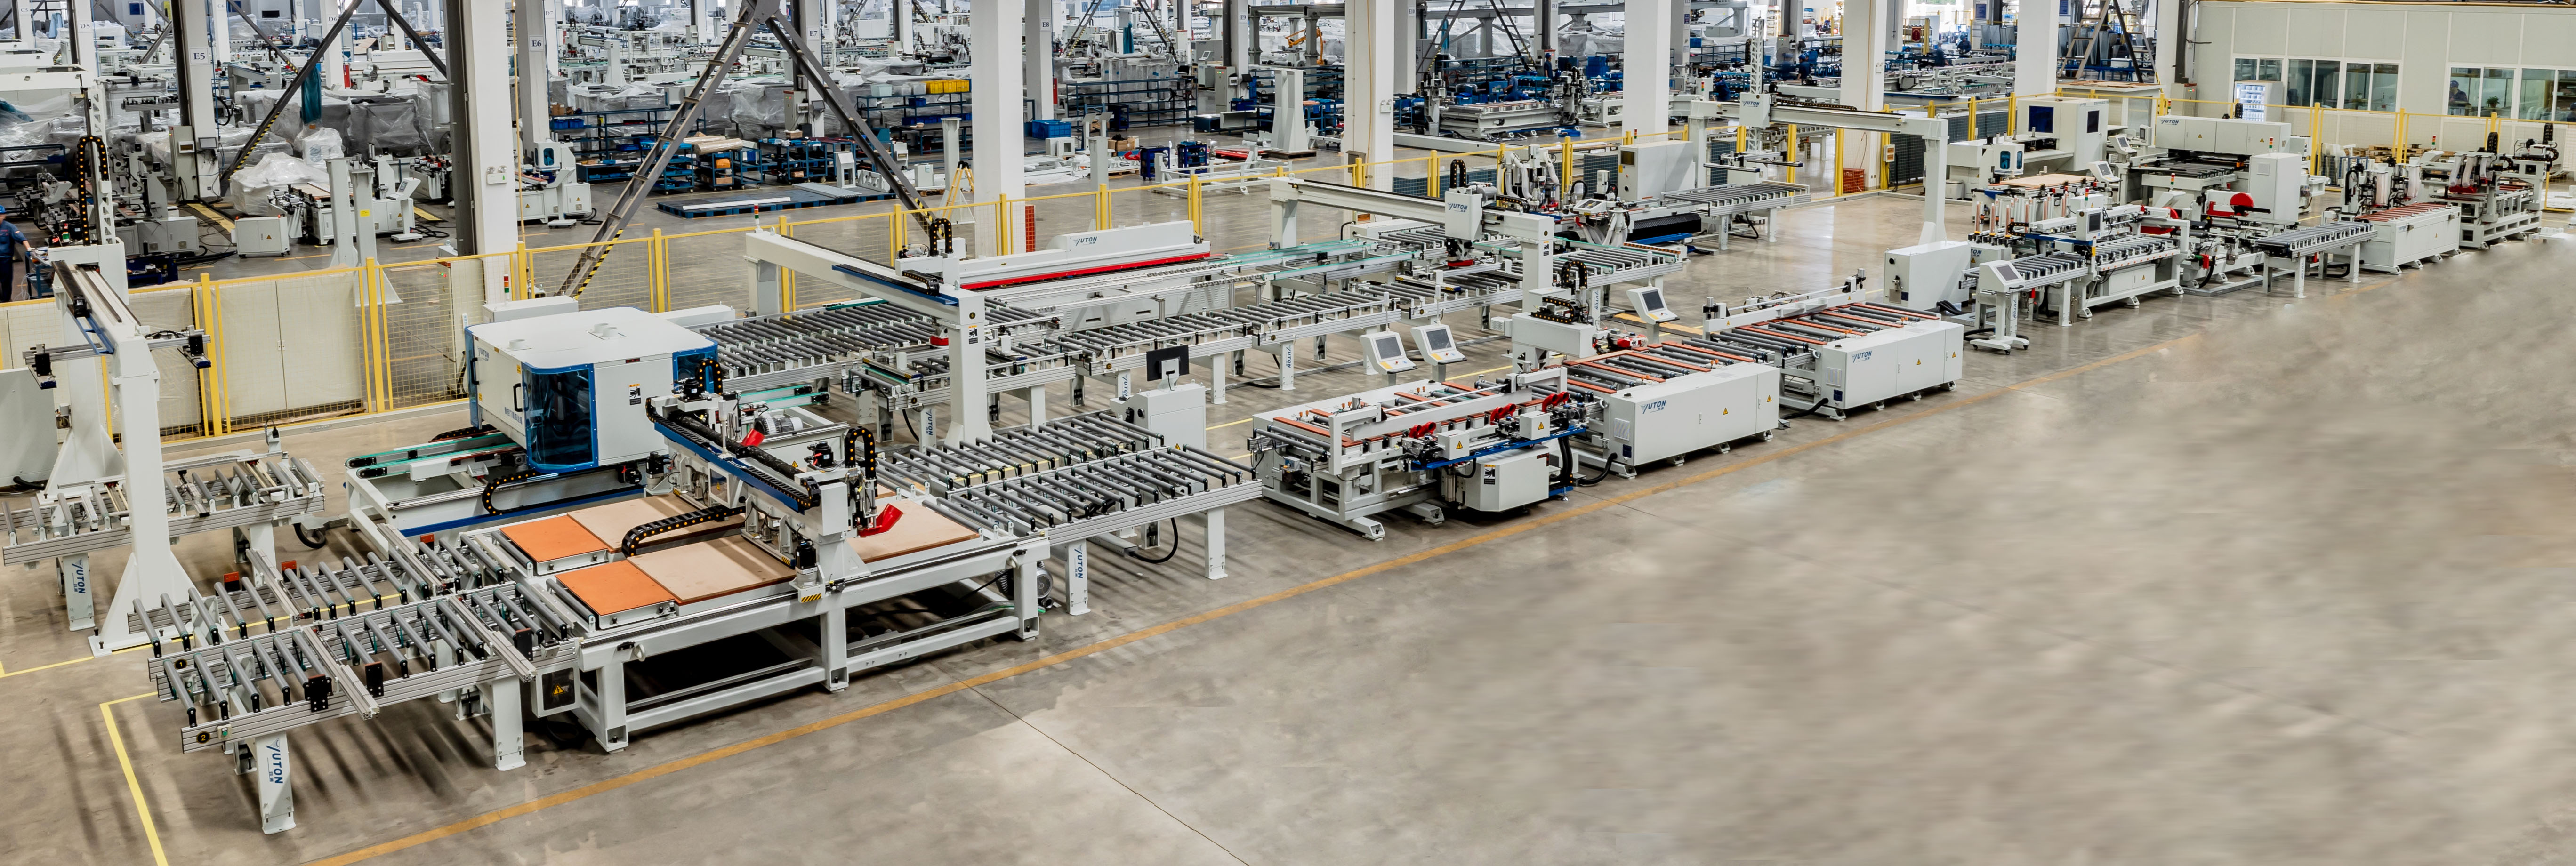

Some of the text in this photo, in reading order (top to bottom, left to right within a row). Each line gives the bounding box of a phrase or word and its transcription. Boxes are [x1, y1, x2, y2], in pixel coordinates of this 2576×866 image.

[1073, 236, 1097, 246] YUTON
[1851, 351, 1872, 363] YUTON
[1640, 400, 1666, 414] YUTON
[1074, 544, 1083, 578] YUTON
[72, 558, 86, 593] YUTON
[266, 738, 283, 784] YUTON
